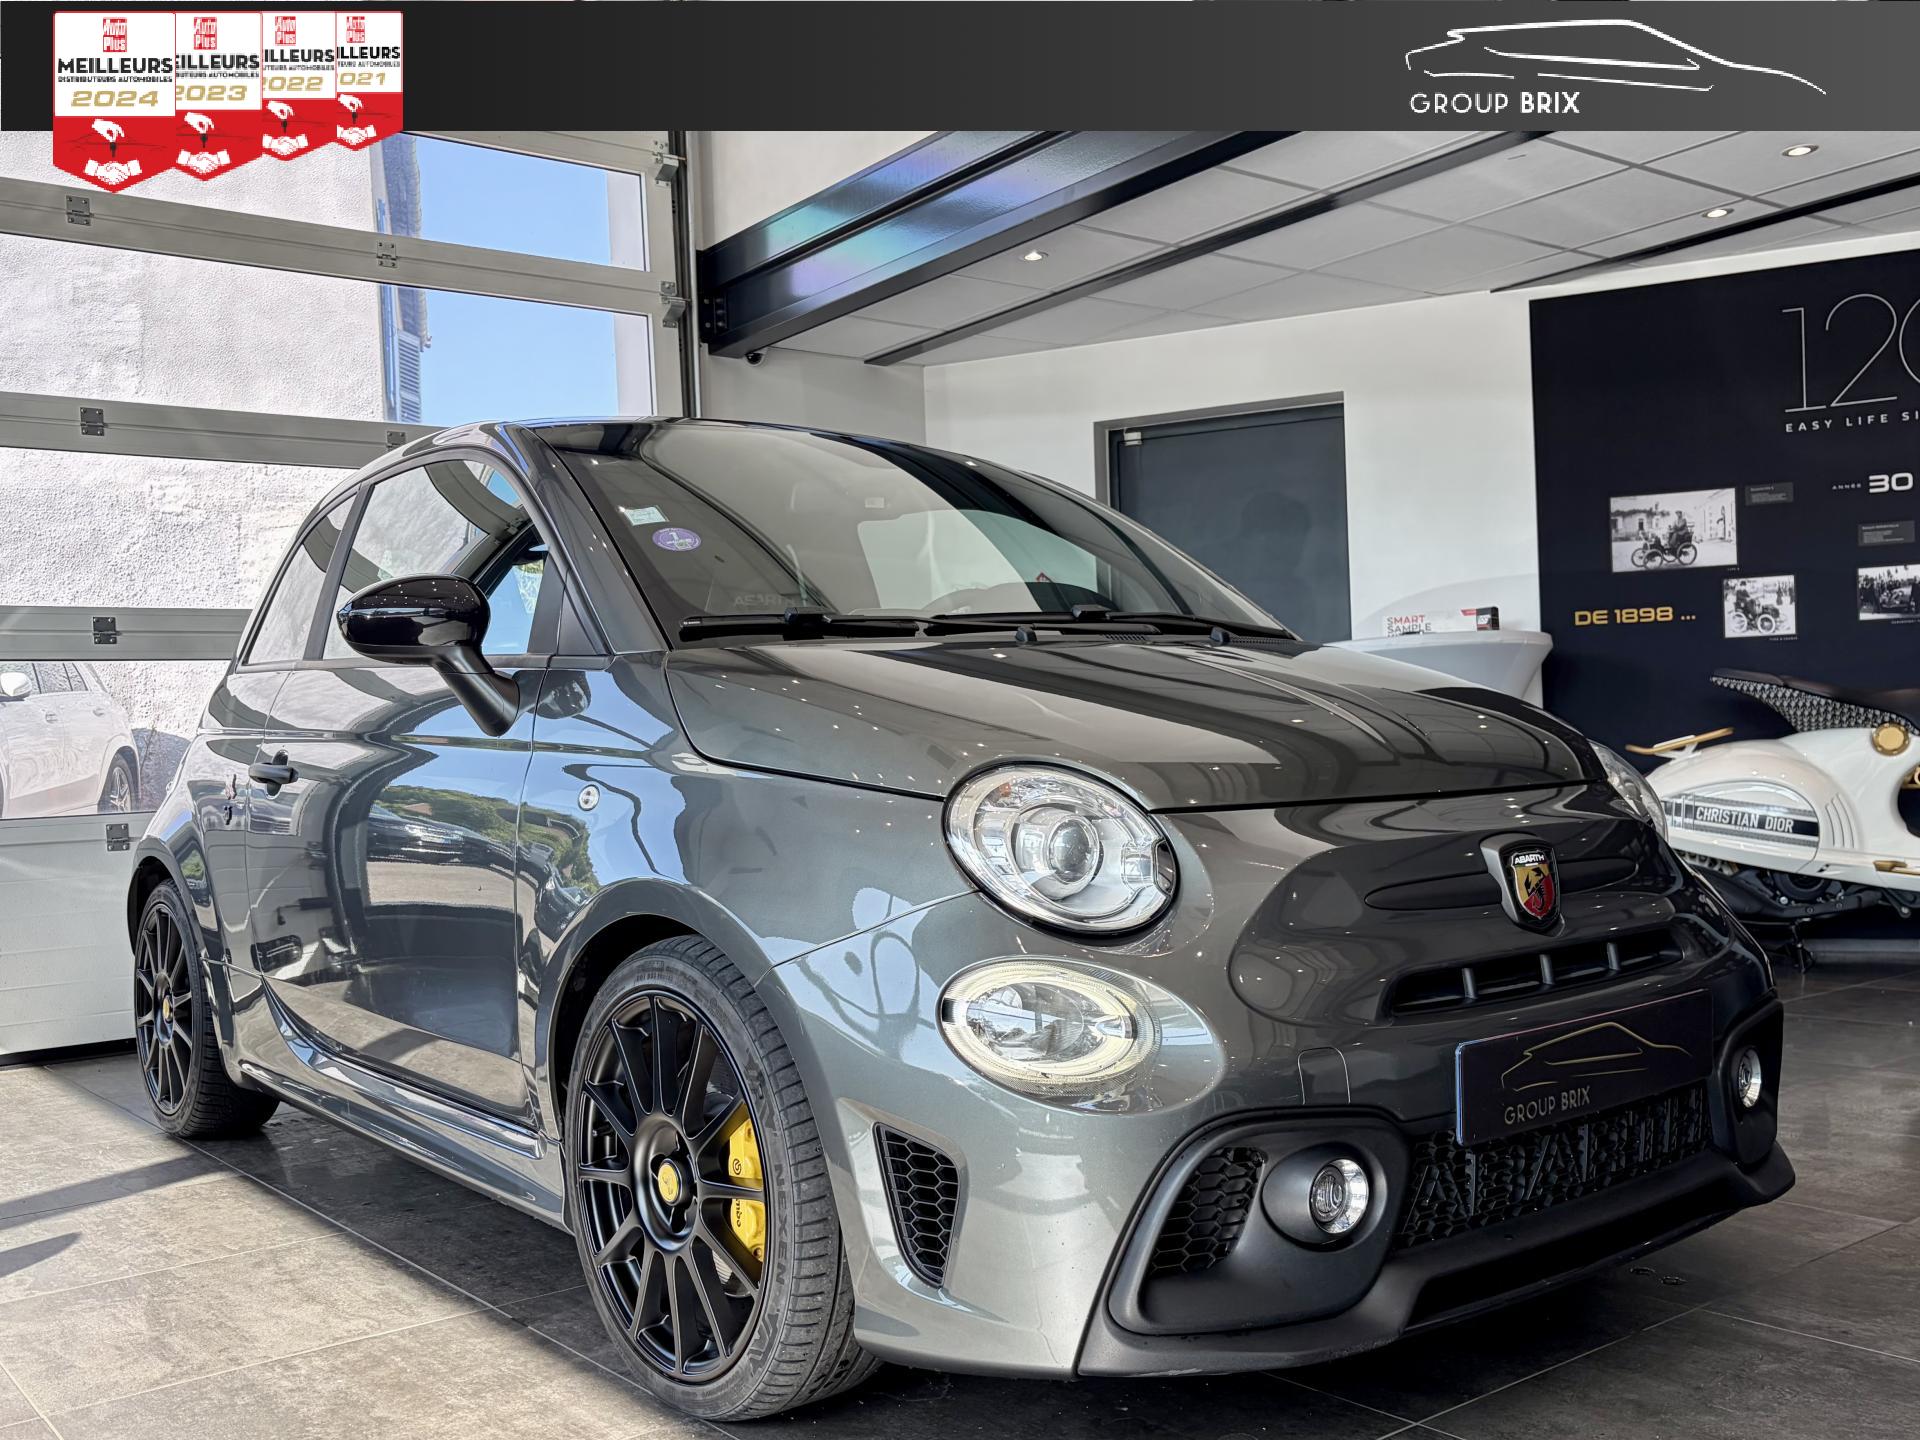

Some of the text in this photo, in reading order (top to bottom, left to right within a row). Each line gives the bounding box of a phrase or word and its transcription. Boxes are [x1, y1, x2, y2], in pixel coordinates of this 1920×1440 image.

[1782, 293, 1920, 413] 12
[1785, 418, 1833, 433] EASY
[1845, 413, 1889, 427] LIFE
[1869, 472, 1914, 493] 30
[1386, 614, 1426, 625] SMART
[1575, 610, 1608, 625] DE
[1614, 607, 1674, 623] 1898
[1387, 623, 1432, 634] SAMPLE
[1695, 806, 1759, 828] CHRISTIAN
[1765, 816, 1795, 833] DIOR
[1514, 854, 1545, 864] ABARTH
[1504, 1085, 1590, 1125] GROUP BRIX
[773, 1162, 790, 1285] NEXEN
